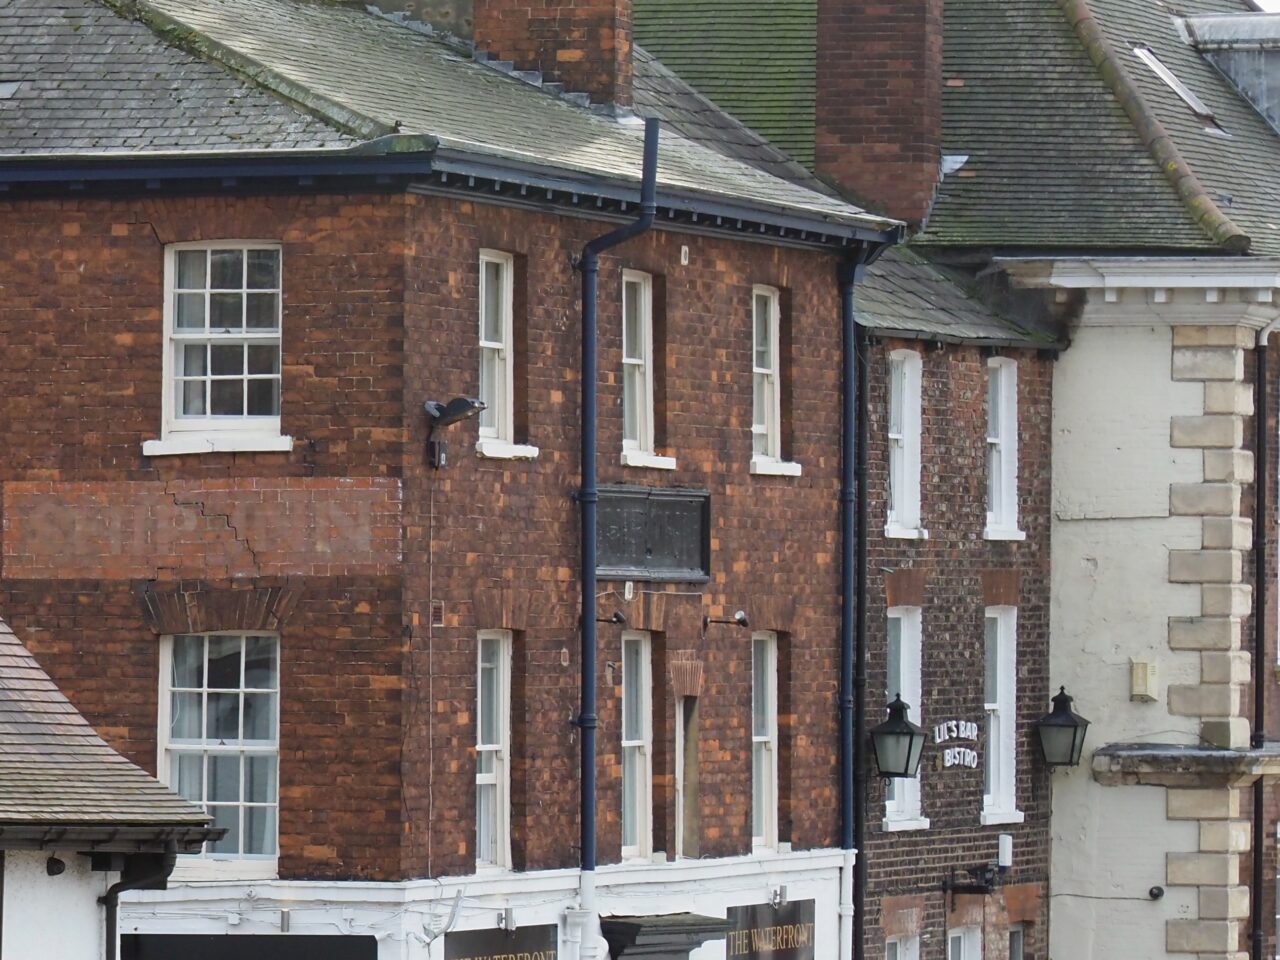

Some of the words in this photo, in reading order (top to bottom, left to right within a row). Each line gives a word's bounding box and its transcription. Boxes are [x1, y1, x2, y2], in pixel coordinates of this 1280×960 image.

[934, 720, 958, 744] LIL'S
[958, 720, 978, 742] BAR
[943, 747, 978, 769] BISTRO
[729, 929, 749, 957] THE
[751, 922, 814, 955] WATERFRONT
